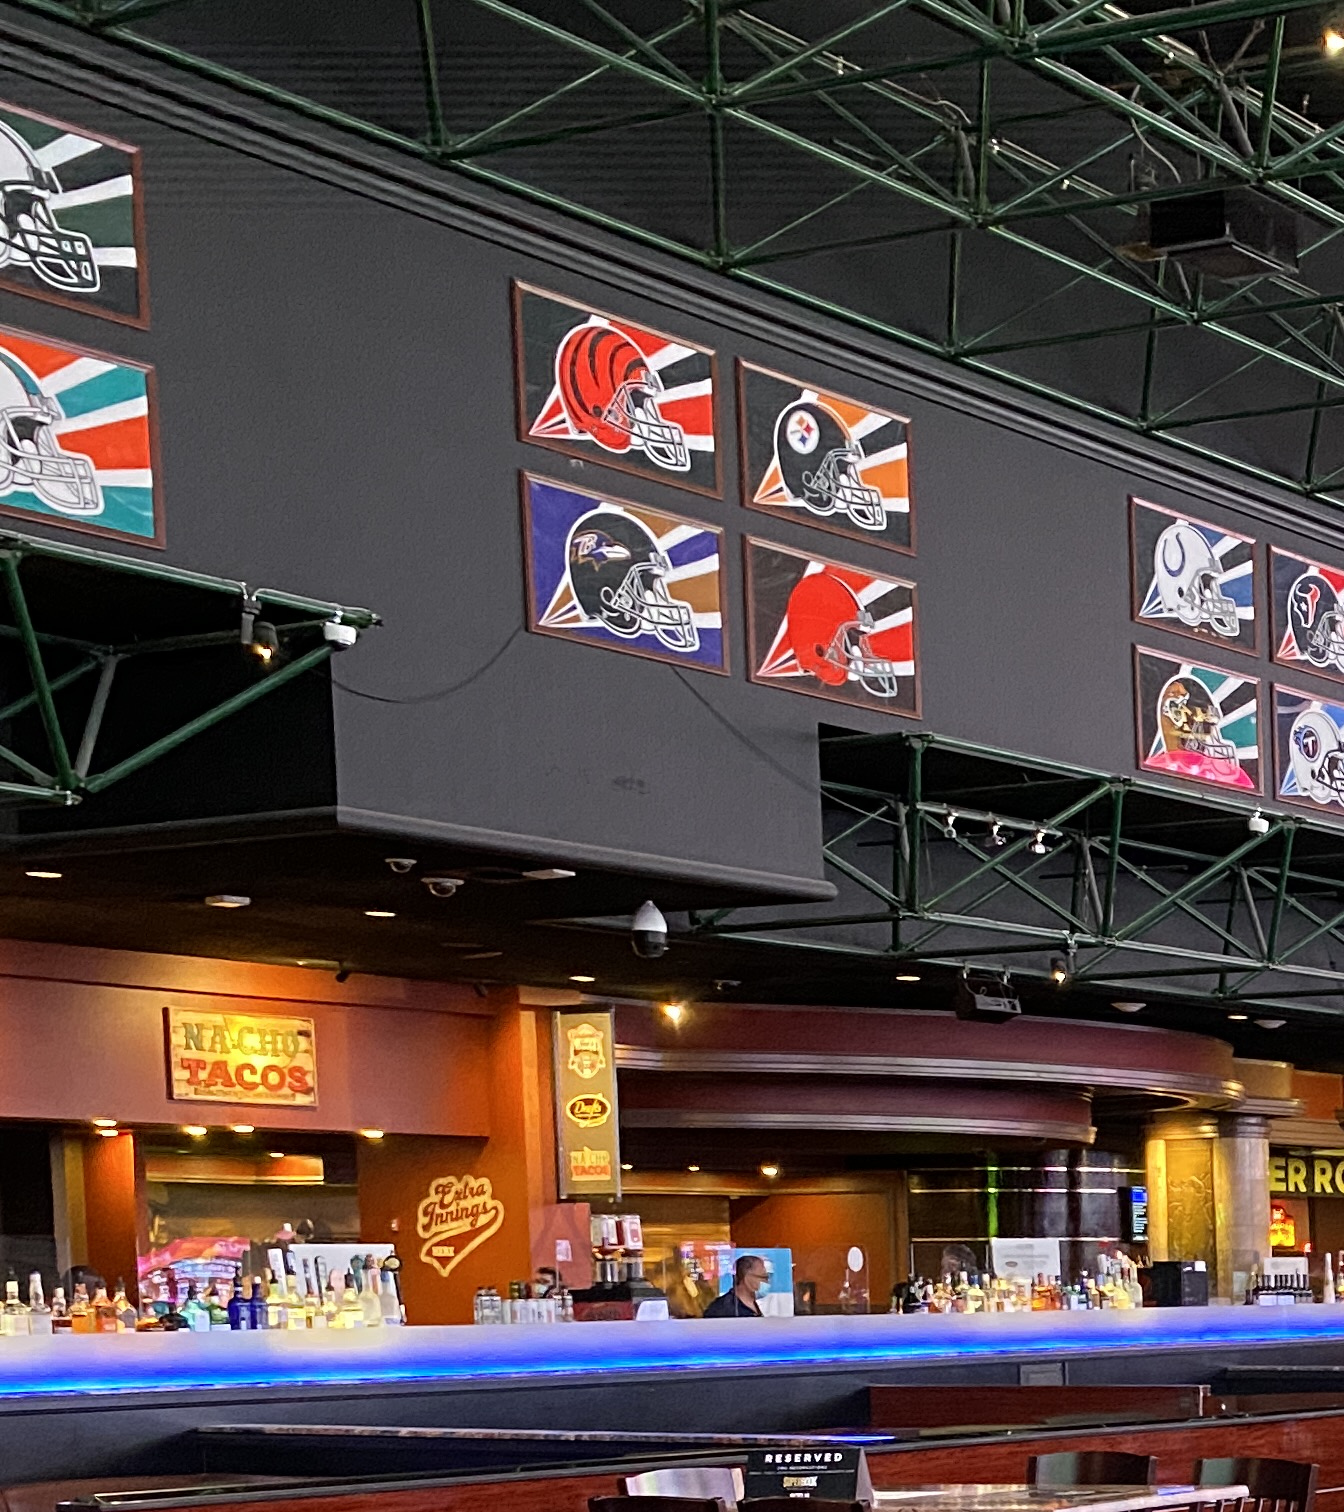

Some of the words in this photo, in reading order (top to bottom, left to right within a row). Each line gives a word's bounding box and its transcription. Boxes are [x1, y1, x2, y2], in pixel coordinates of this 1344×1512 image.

[182, 1022, 300, 1058] NACHO
[180, 1058, 311, 1094] TACOS
[422, 1201, 489, 1233] Innings
[764, 1452, 843, 1463] RESERVED
